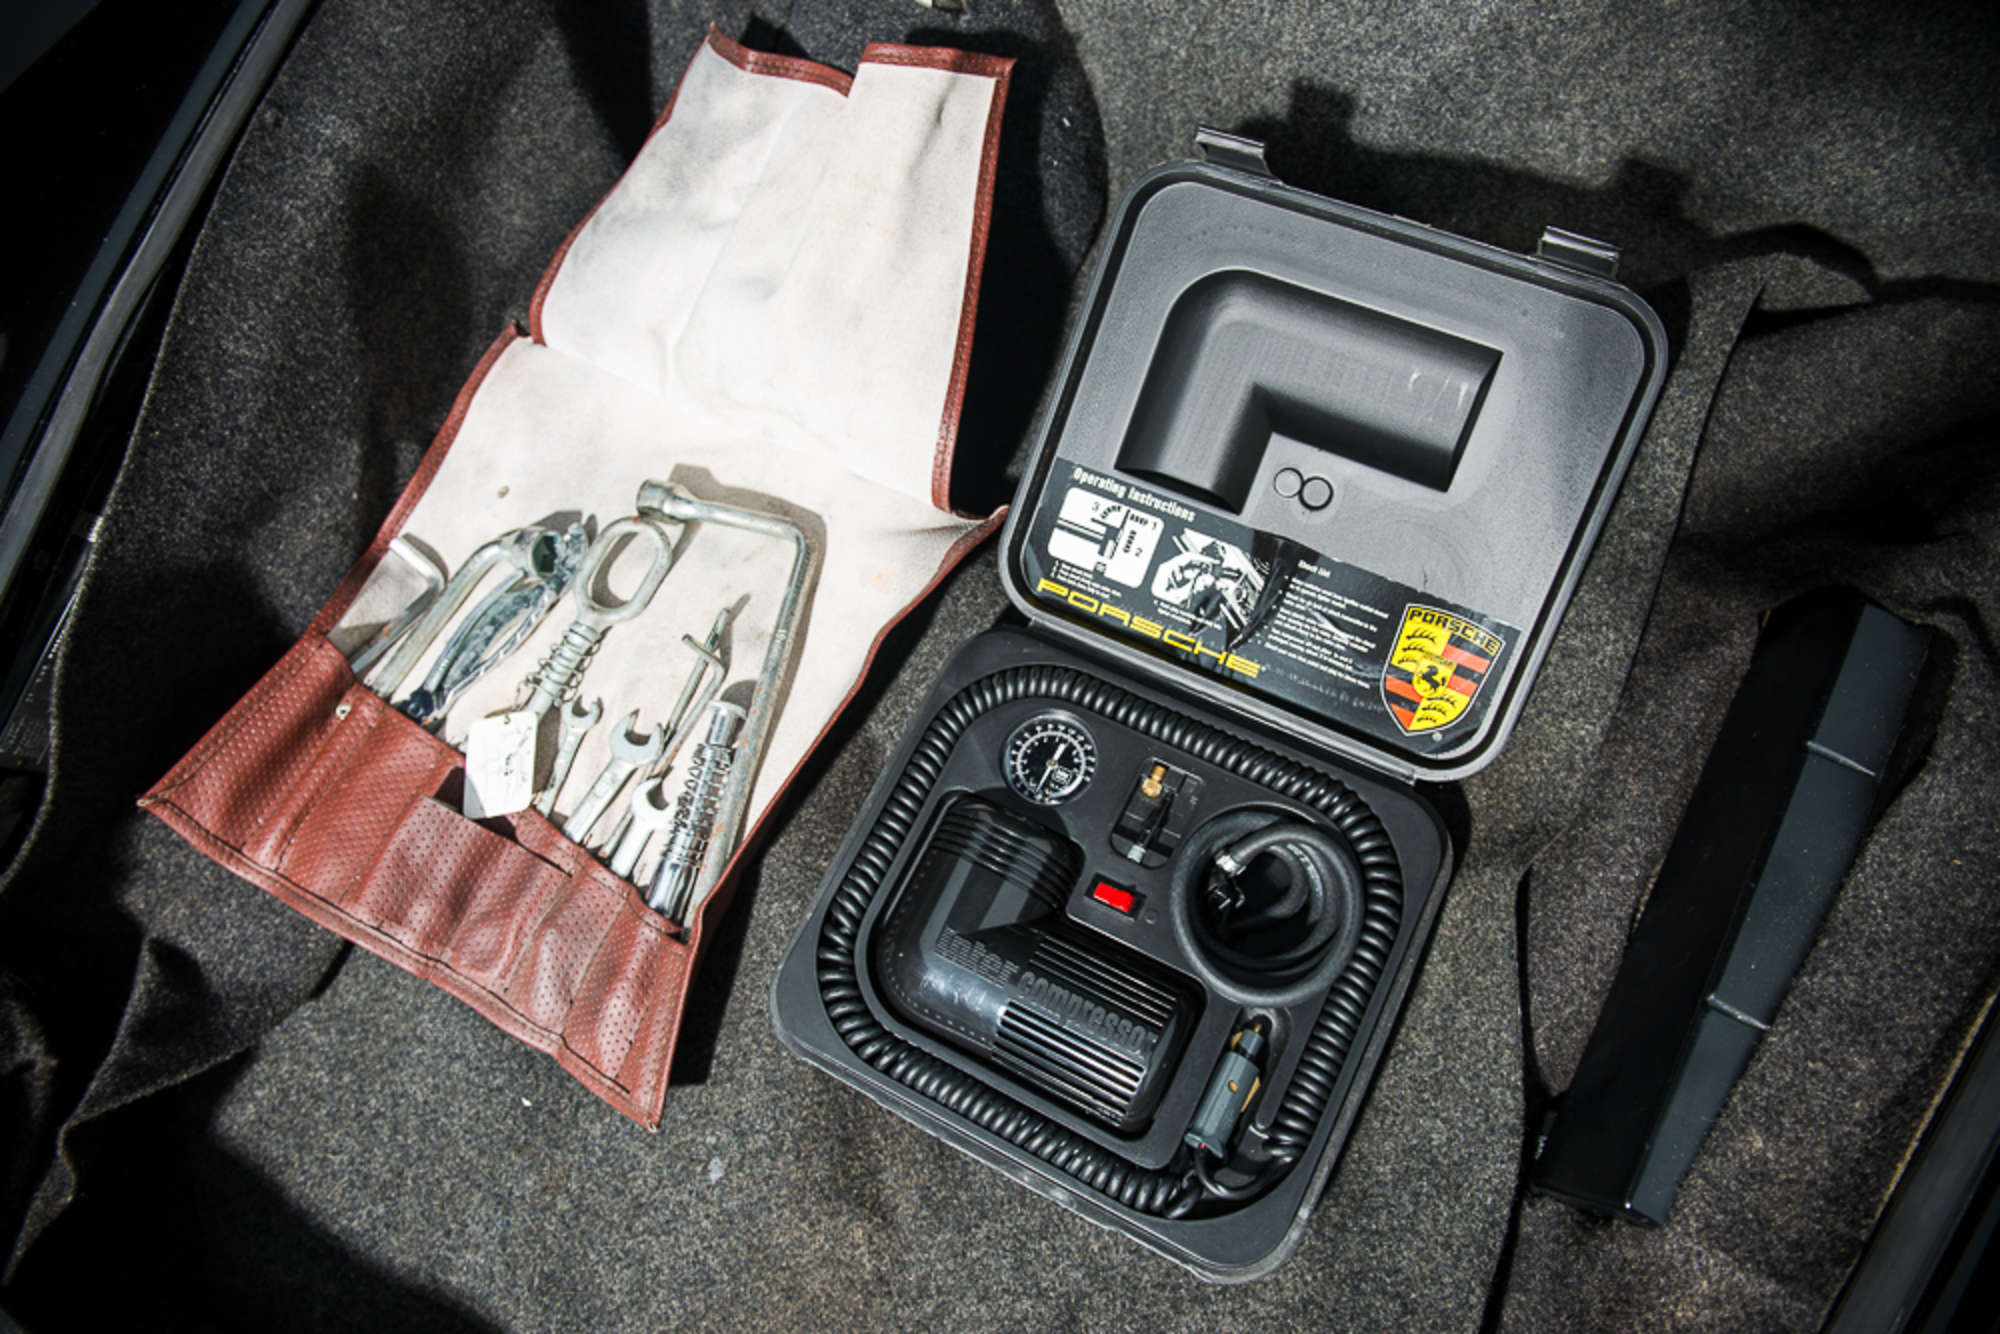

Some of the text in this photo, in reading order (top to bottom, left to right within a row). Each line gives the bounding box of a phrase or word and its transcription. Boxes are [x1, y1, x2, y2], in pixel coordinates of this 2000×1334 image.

[1073, 467, 1127, 499] Operating
[1037, 578, 1261, 678] PORSCHE
[1409, 608, 1500, 654] PORSCHE
[1020, 971, 1158, 1054] compressor
